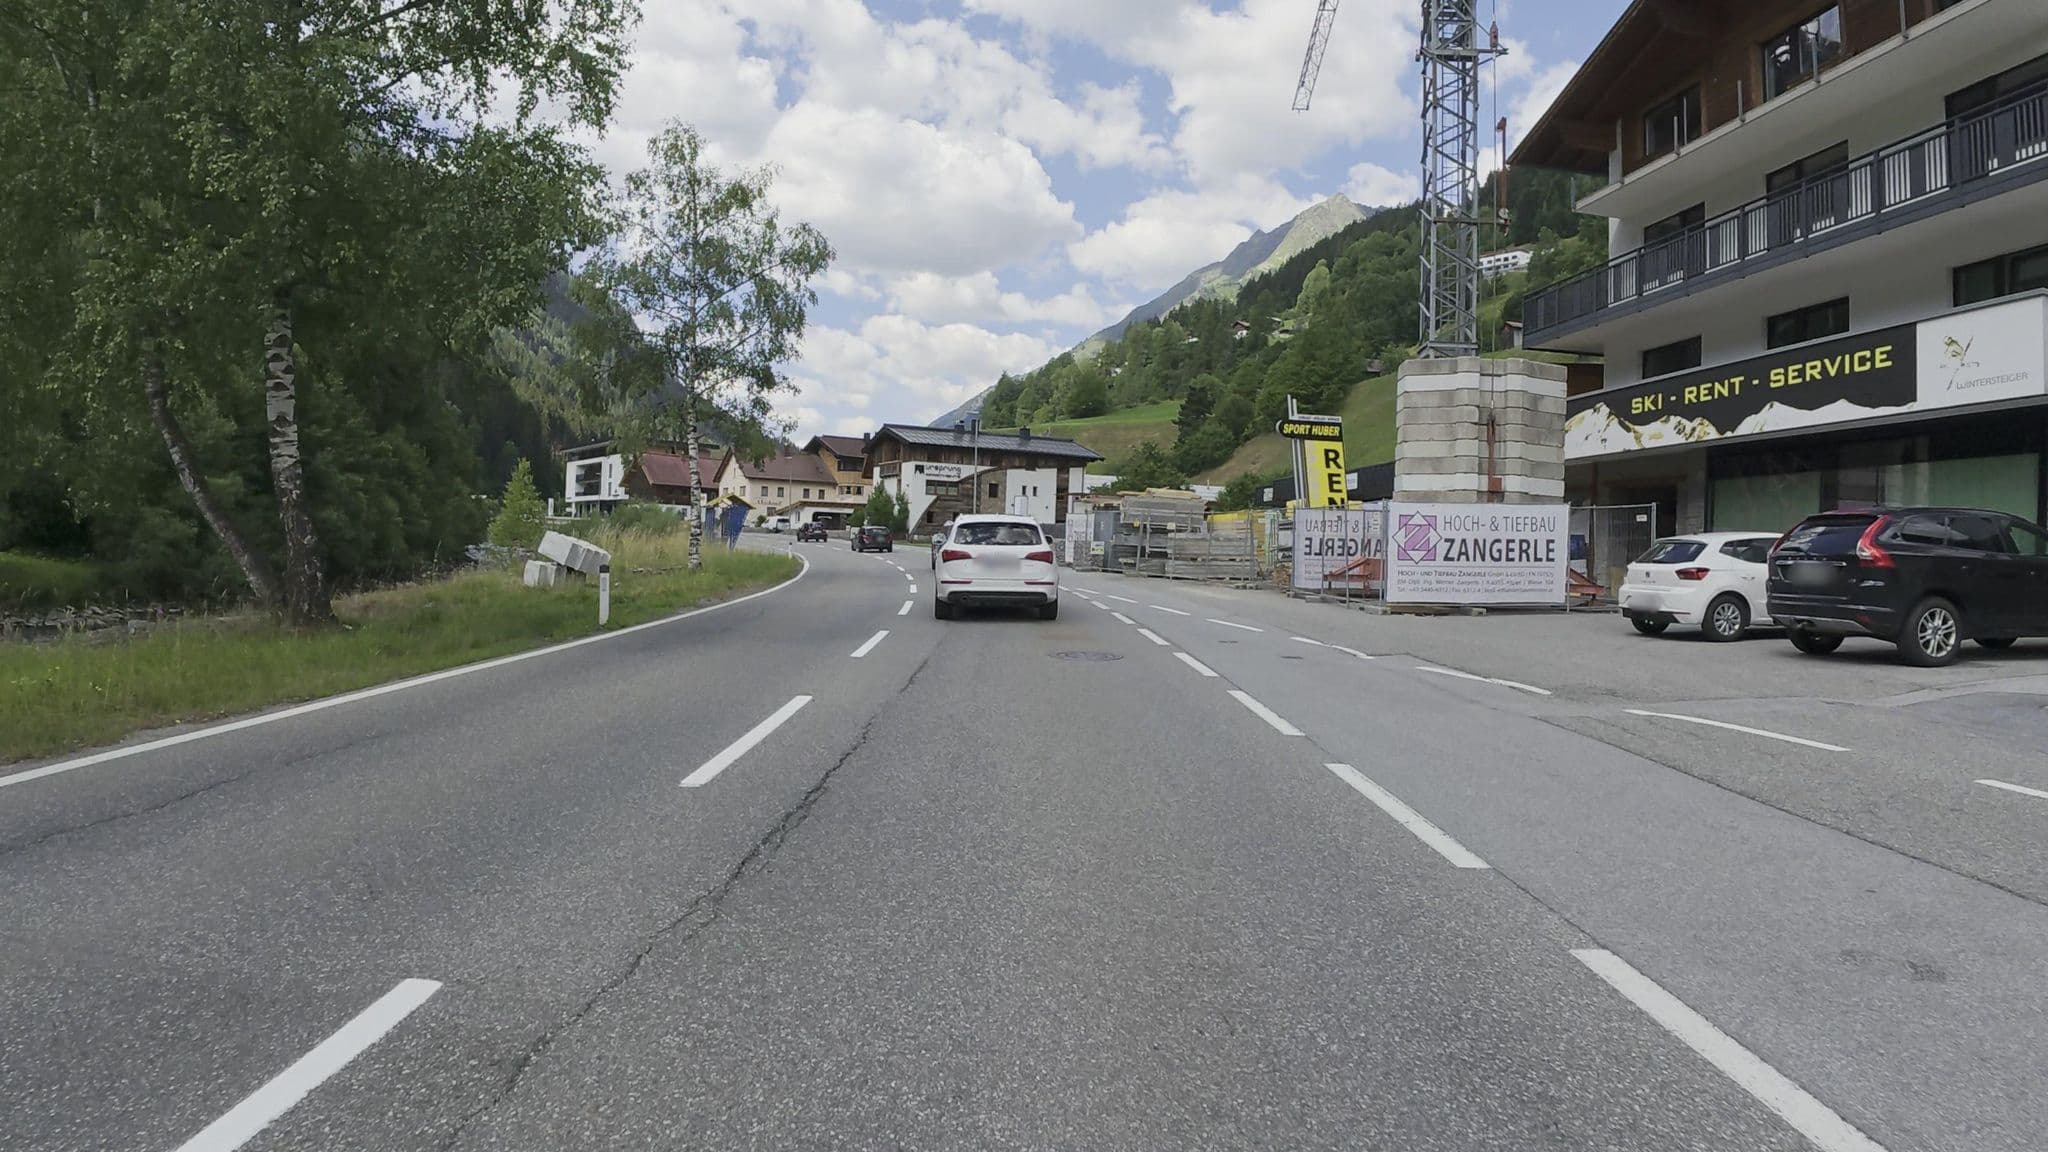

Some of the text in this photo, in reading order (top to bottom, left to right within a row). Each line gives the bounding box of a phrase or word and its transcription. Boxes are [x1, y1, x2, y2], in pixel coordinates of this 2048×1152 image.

[1631, 393, 1663, 415] SKI
[1684, 375, 1745, 405] RENT
[1768, 344, 1893, 389] SERVICE
[1956, 371, 2029, 391] WINTERSTEIGER
[1283, 423, 1341, 437] SPORT HUBER
[1443, 514, 1556, 533] HOCH- & TIEFBAU
[1443, 538, 1556, 562] ZANGERLE
